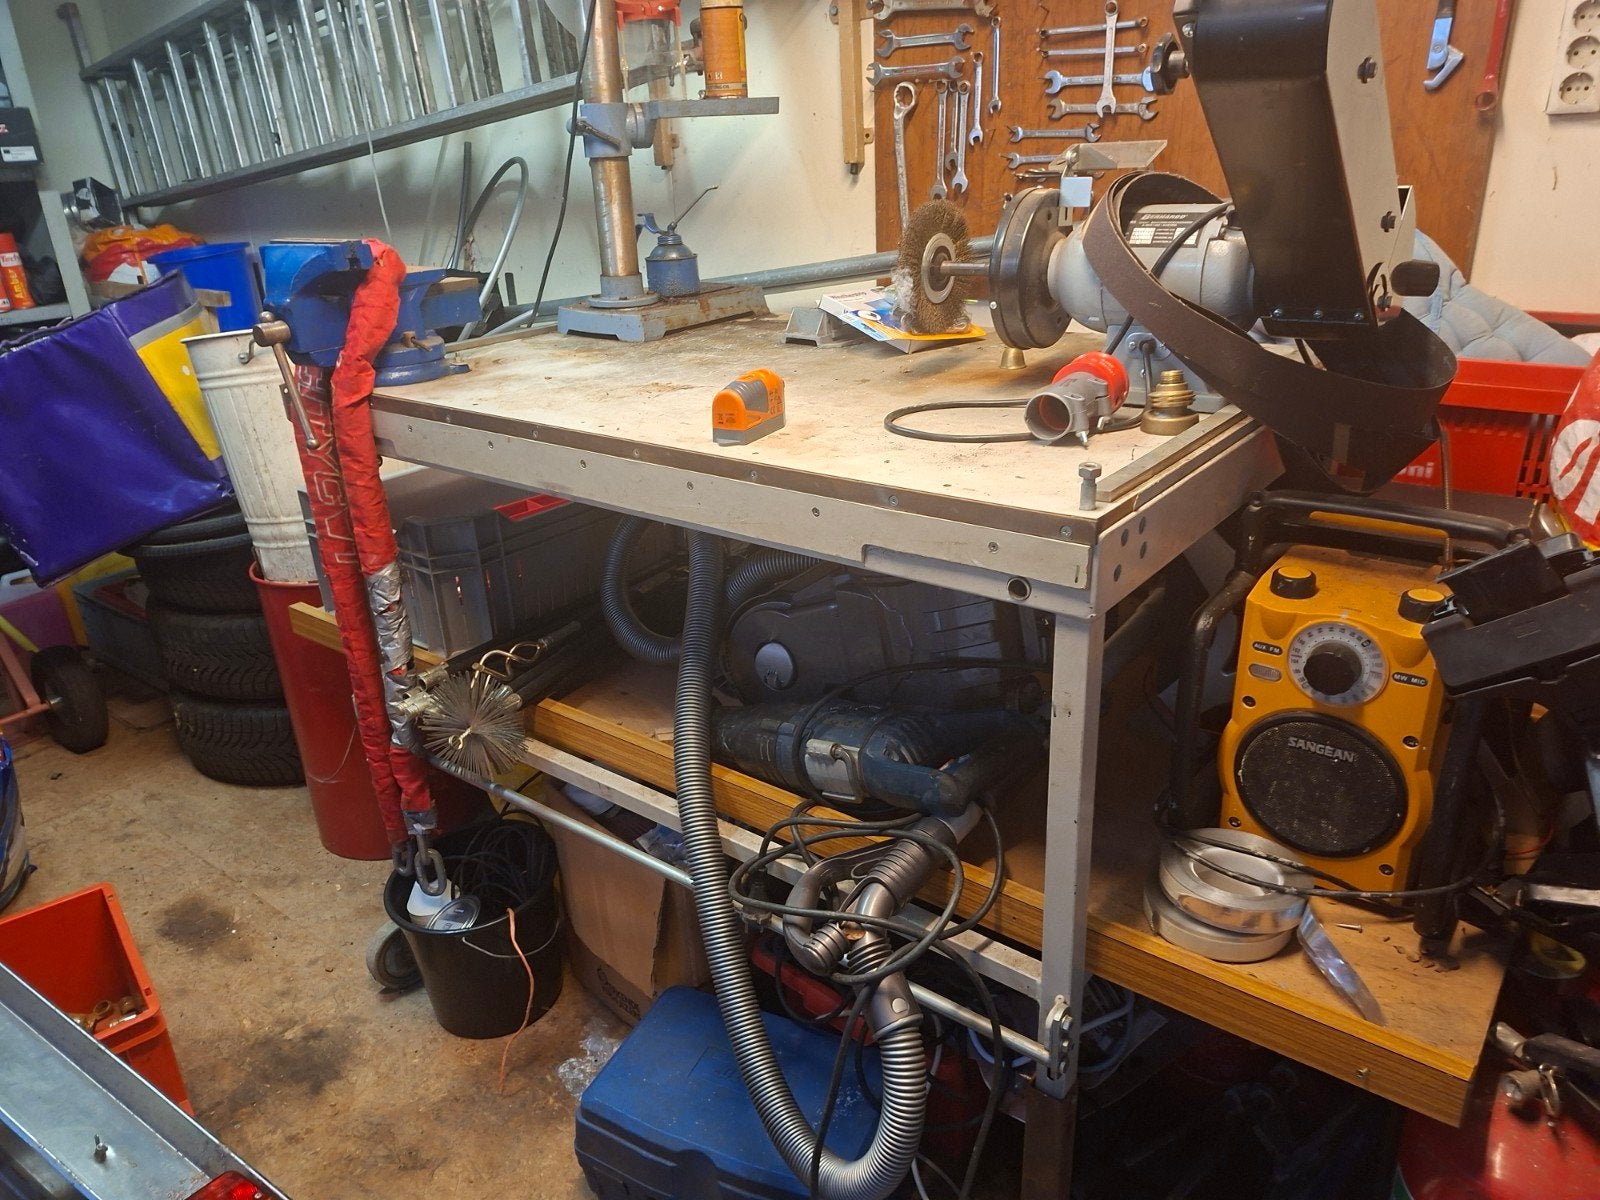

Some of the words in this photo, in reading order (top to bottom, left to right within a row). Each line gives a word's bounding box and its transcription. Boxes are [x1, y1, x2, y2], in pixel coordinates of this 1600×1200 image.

[8, 269, 25, 299] Amber
[1253, 643, 1267, 651] AUX
[1269, 646, 1280, 655] FM
[1394, 673, 1408, 683] MW
[1411, 677, 1426, 686] MIC
[1287, 736, 1354, 763] SANGEAN
